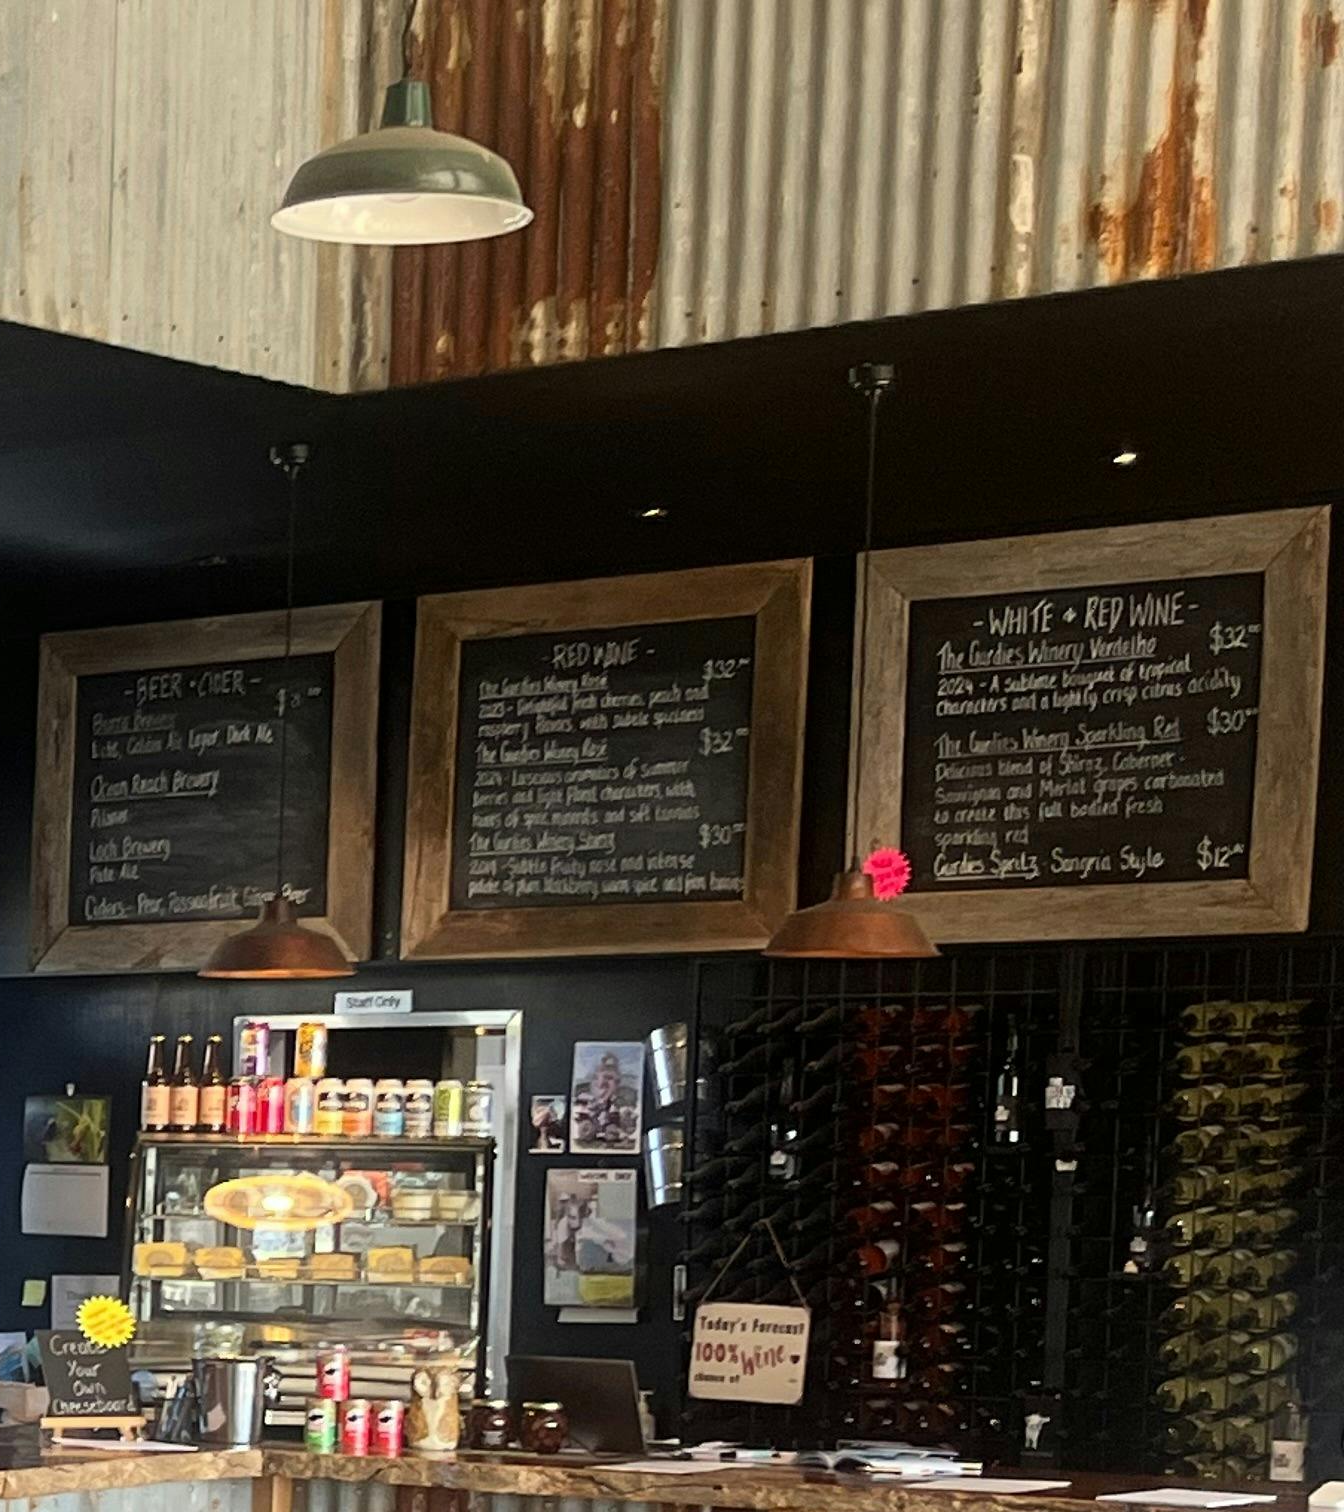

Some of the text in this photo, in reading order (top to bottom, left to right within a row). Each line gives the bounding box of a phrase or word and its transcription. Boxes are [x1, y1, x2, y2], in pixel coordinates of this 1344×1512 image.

[989, 597, 1055, 636] WHITE
[1084, 596, 1124, 634] RED
[1129, 591, 1185, 627] WINE
[937, 641, 964, 672] The
[1027, 639, 1084, 672] Winery
[1089, 631, 1158, 660] Verdelho
[1120, 845, 1165, 878] Style
[699, 1315, 746, 1334] Today's
[696, 1342, 739, 1364] 100%
